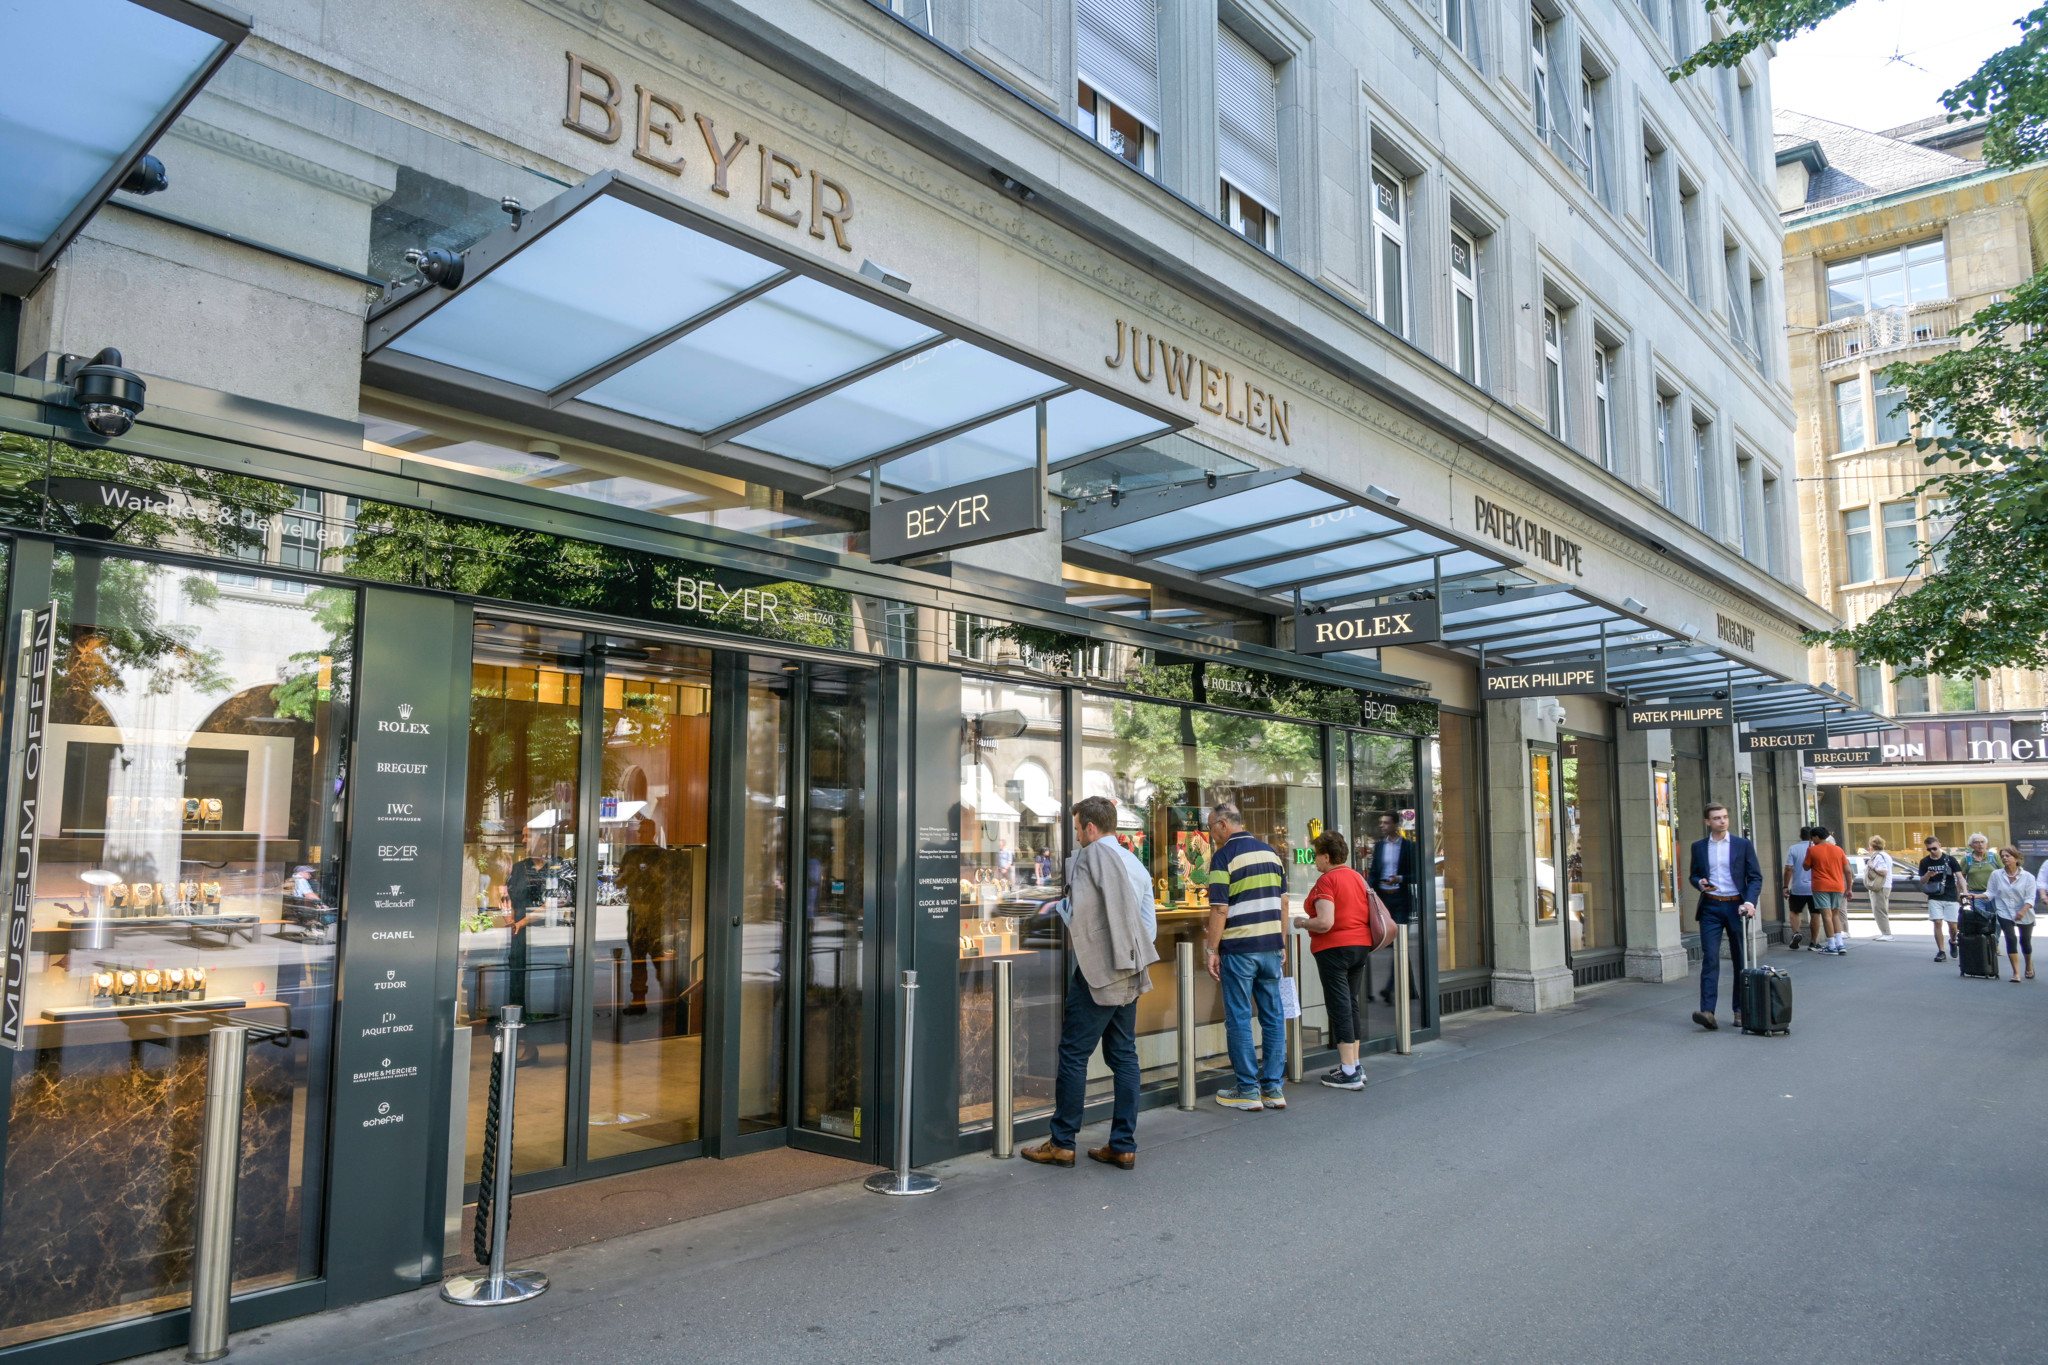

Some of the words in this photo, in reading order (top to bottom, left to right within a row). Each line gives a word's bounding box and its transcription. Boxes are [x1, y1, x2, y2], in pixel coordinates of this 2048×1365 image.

[563, 51, 853, 252] BEYER
[1105, 319, 1290, 446] JUWELEN
[100, 485, 209, 523] Watches
[217, 506, 236, 526] &
[242, 511, 351, 549] Jewellery
[906, 494, 990, 539] BEYER
[1475, 495, 1524, 551] PATEK
[1523, 518, 1584, 577] PHILIPPE
[676, 576, 780, 624] BEYER
[792, 607, 811, 622] Seit
[1316, 613, 1413, 643] ROLEX
[1716, 612, 1756, 653] BREGUET
[1212, 677, 1243, 693] ROLEX
[1487, 674, 1529, 691] PATEK
[1532, 670, 1595, 688] PHILIPPE
[1364, 700, 1397, 722] BEYER
[1632, 710, 1669, 724] PATEK
[1670, 707, 1723, 722] PHILIPPE
[378, 720, 430, 734] ROLEX
[1750, 733, 1815, 748] BREGUET
[1814, 751, 1870, 763] BREGUET
[377, 762, 428, 774] BREGUET
[387, 803, 413, 815] IWC
[4, 799, 36, 1036] MUSEUM
[26, 612, 50, 780] OFFEN
[378, 845, 418, 857] BEYER
[1296, 848, 1316, 864] RO
[374, 898, 415, 908] Wellendorff
[372, 931, 415, 940] CHANEL
[374, 981, 406, 990] TUDOR
[362, 1026, 391, 1037] JAQUET
[393, 1024, 414, 1033] DROZ
[353, 1071, 379, 1080] BAUME
[385, 1066, 417, 1075] MERCIER
[363, 1114, 404, 1127] scheffel
